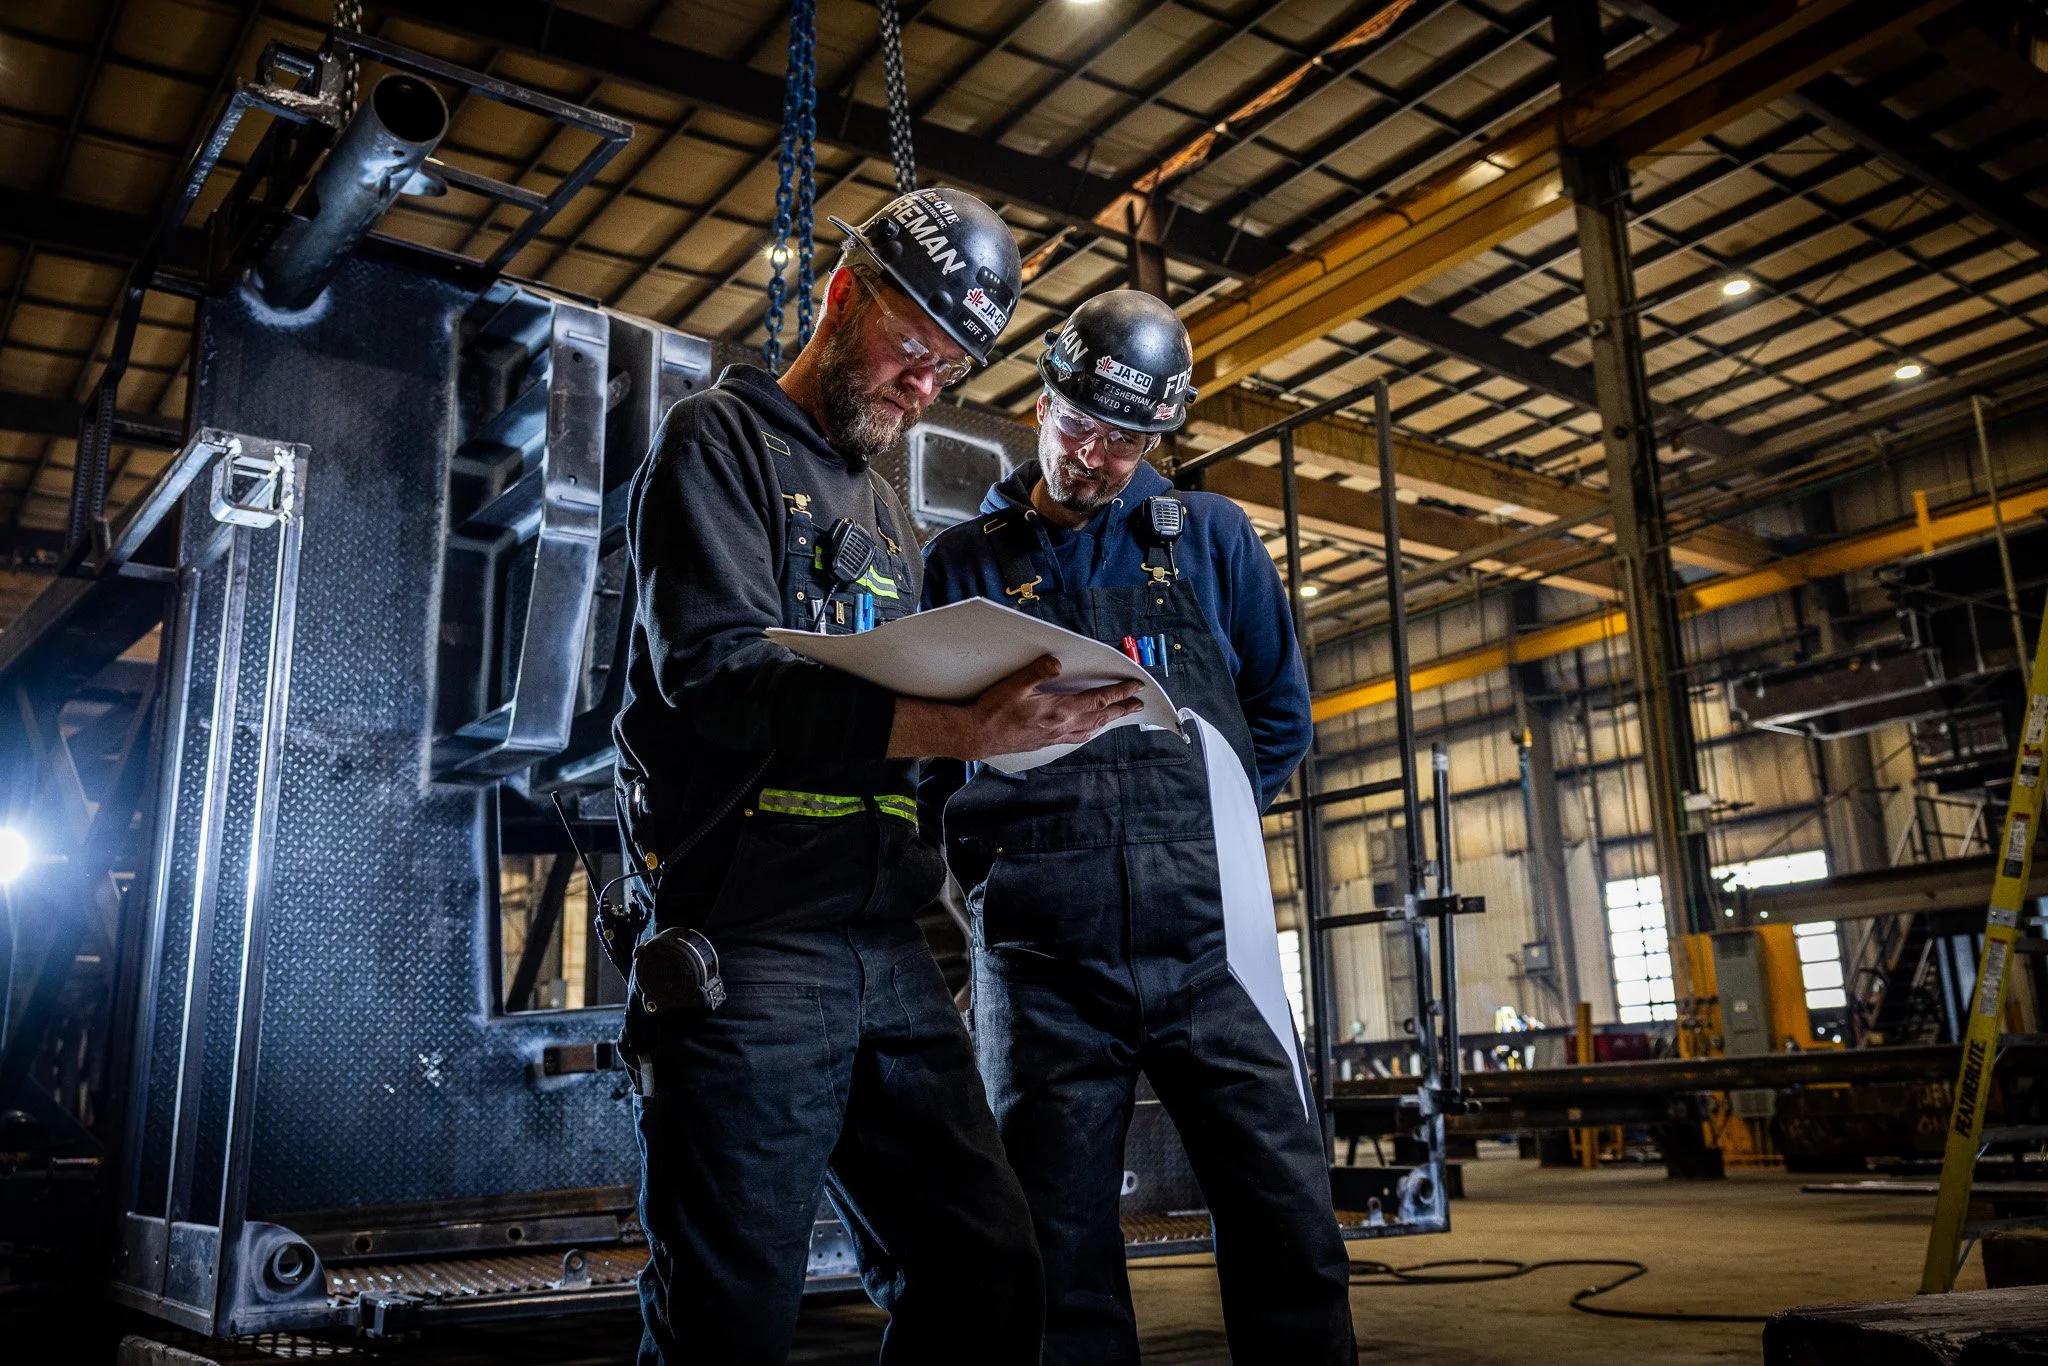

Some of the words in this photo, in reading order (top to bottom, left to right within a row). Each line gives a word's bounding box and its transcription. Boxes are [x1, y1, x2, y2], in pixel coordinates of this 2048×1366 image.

[886, 196, 967, 276] REMAN
[963, 319, 982, 335] JEFF
[980, 334, 988, 342] S
[1086, 374, 1101, 387] THE
[1104, 384, 1151, 406] FISHERMAN
[1093, 393, 1121, 409] DAVID
[1123, 405, 1131, 413] G
[1955, 1039, 1987, 1139] FEATHERLITE
